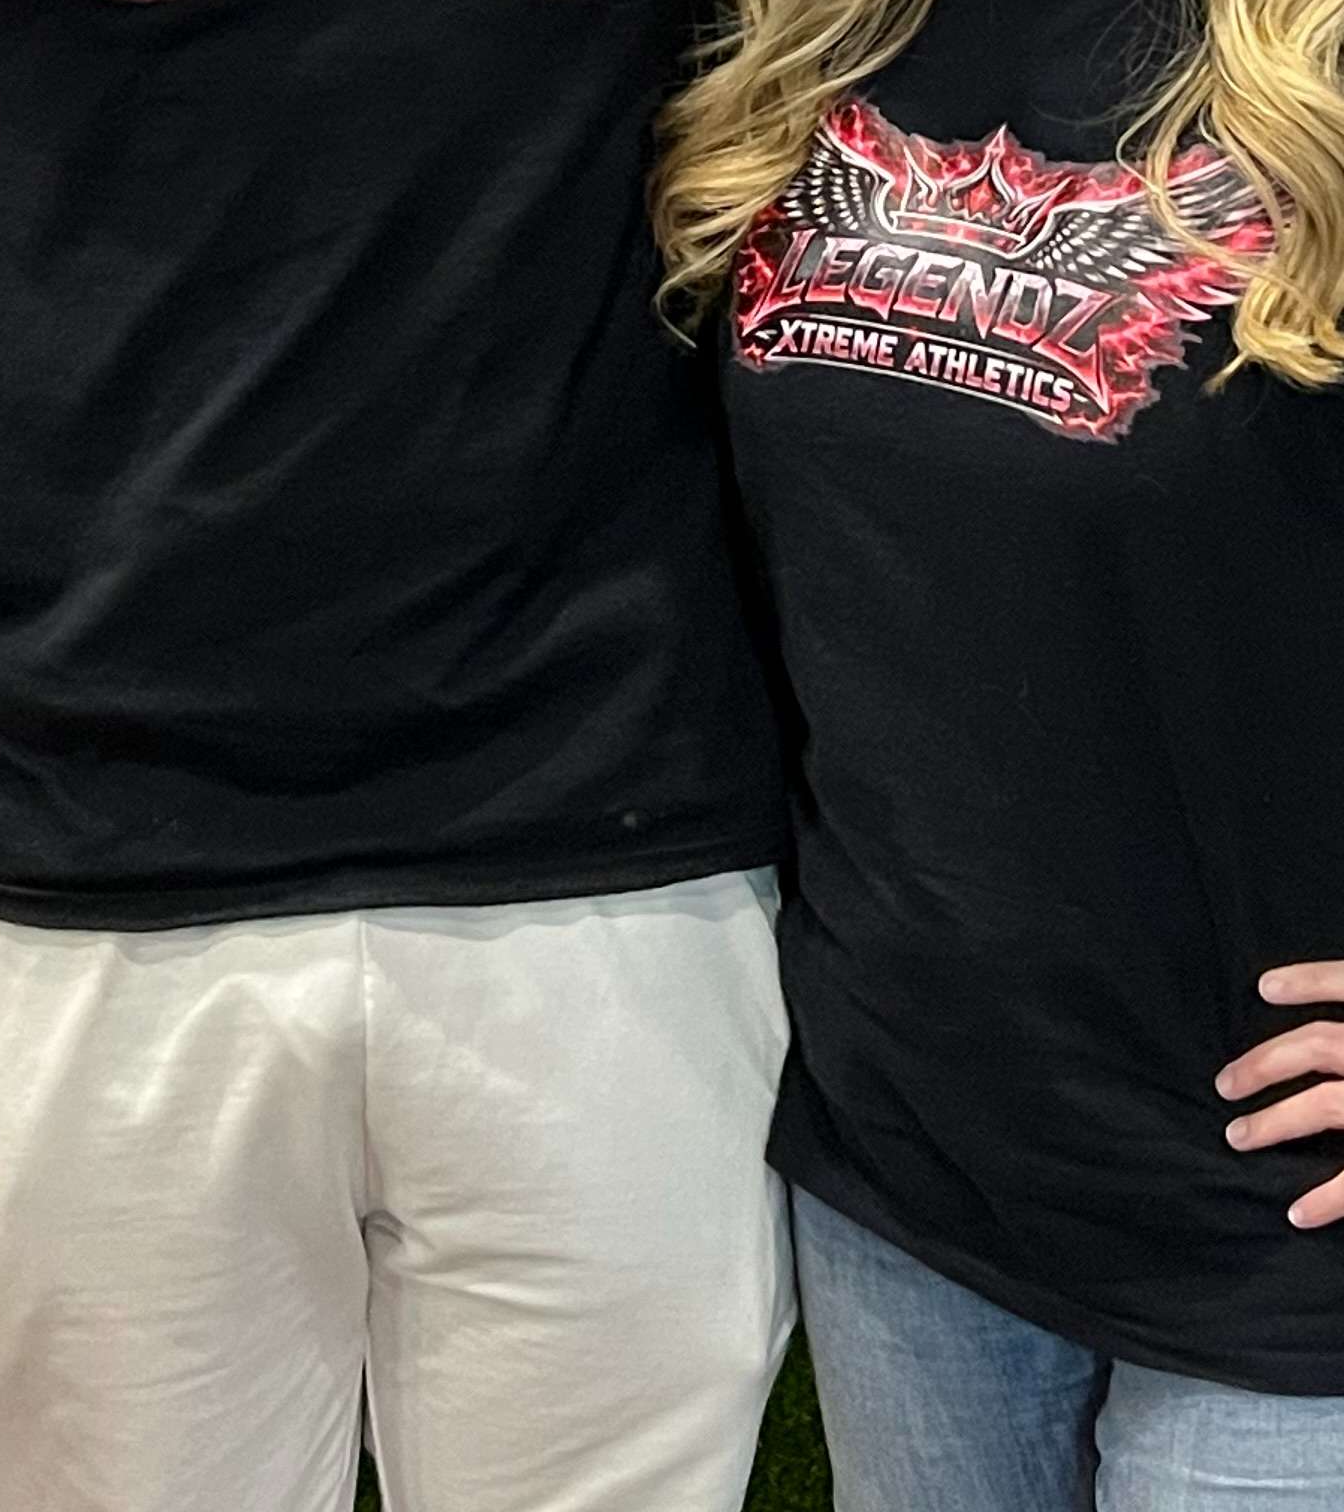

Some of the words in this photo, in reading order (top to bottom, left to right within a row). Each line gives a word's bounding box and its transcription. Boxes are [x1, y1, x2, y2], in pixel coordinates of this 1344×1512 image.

[742, 228, 1111, 414] LEGENDZ
[771, 318, 899, 367] XTREME
[903, 341, 1074, 413] ATHLETICS
